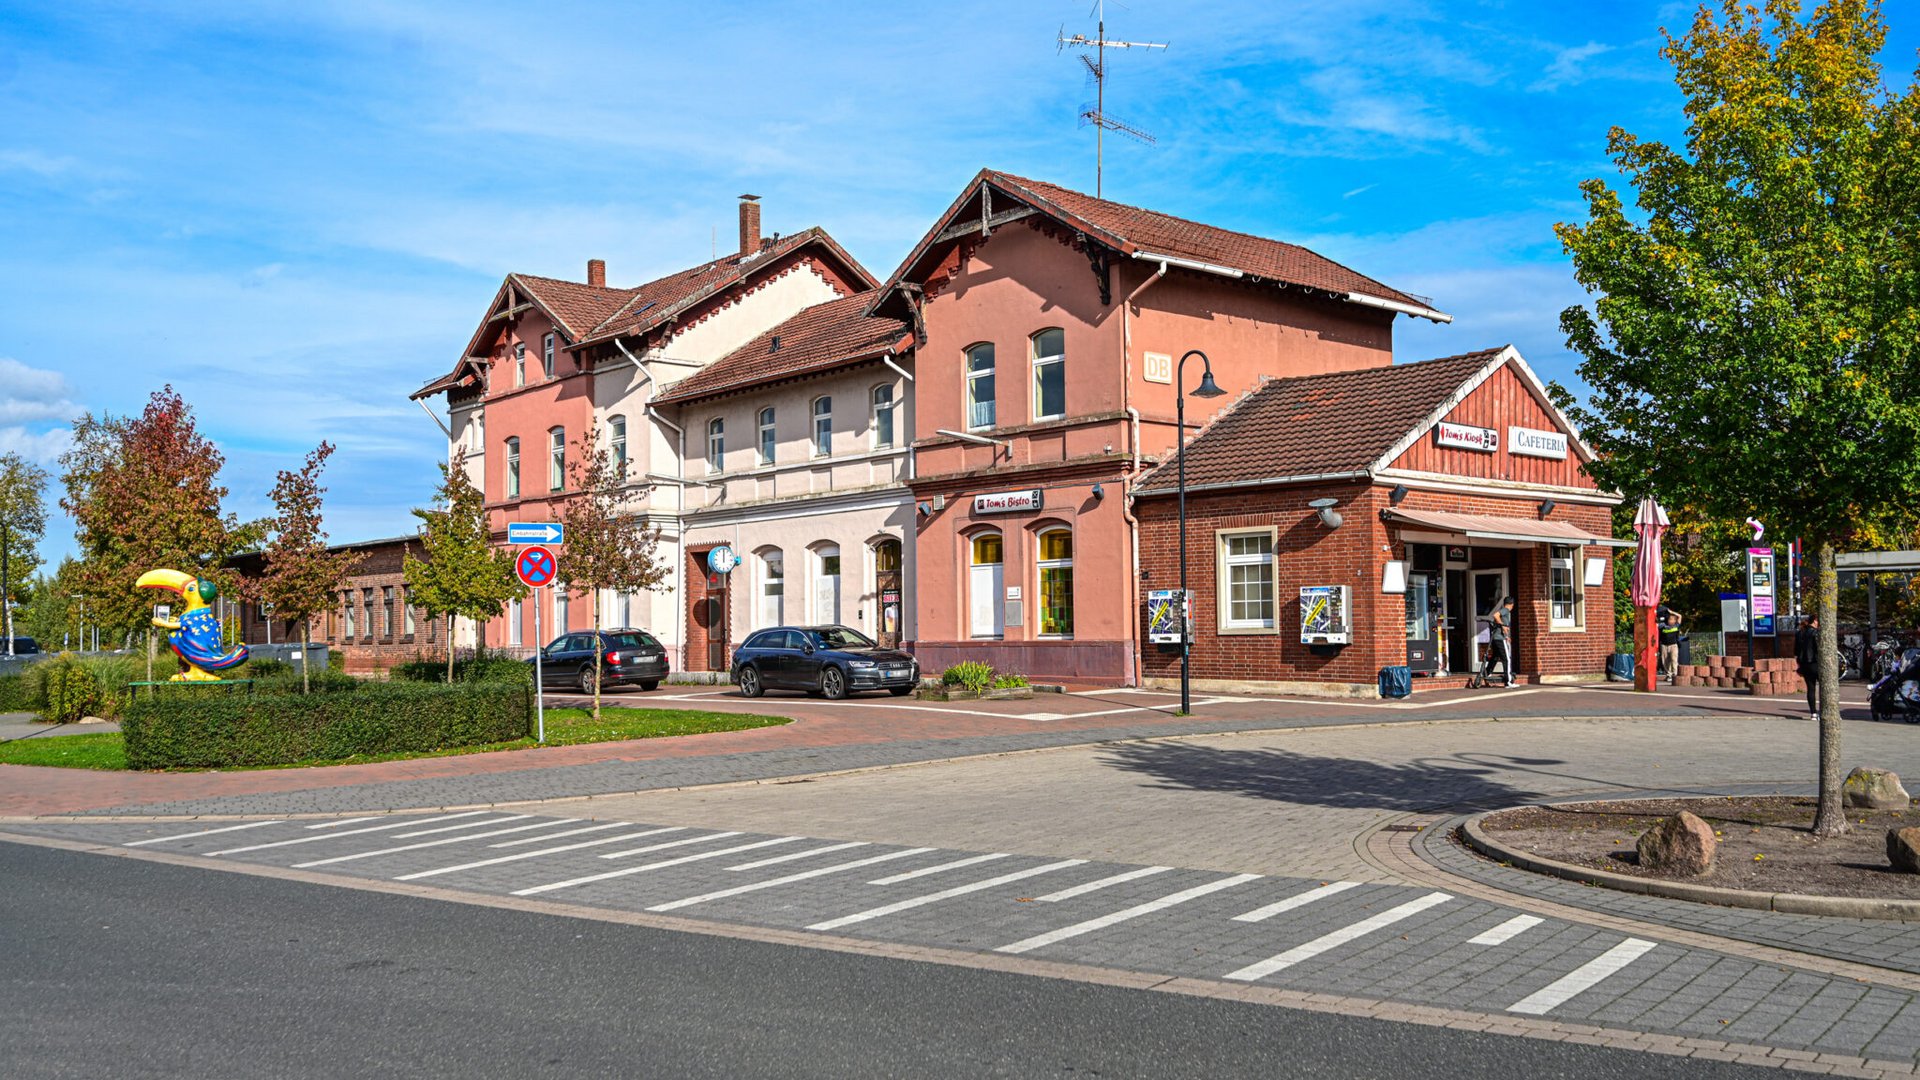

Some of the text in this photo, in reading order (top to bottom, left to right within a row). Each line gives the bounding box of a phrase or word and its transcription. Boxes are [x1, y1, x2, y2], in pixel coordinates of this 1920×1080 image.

[1148, 357, 1169, 379] DB
[1464, 431, 1482, 445] Kiosk
[1007, 496, 1029, 508] Bistro
